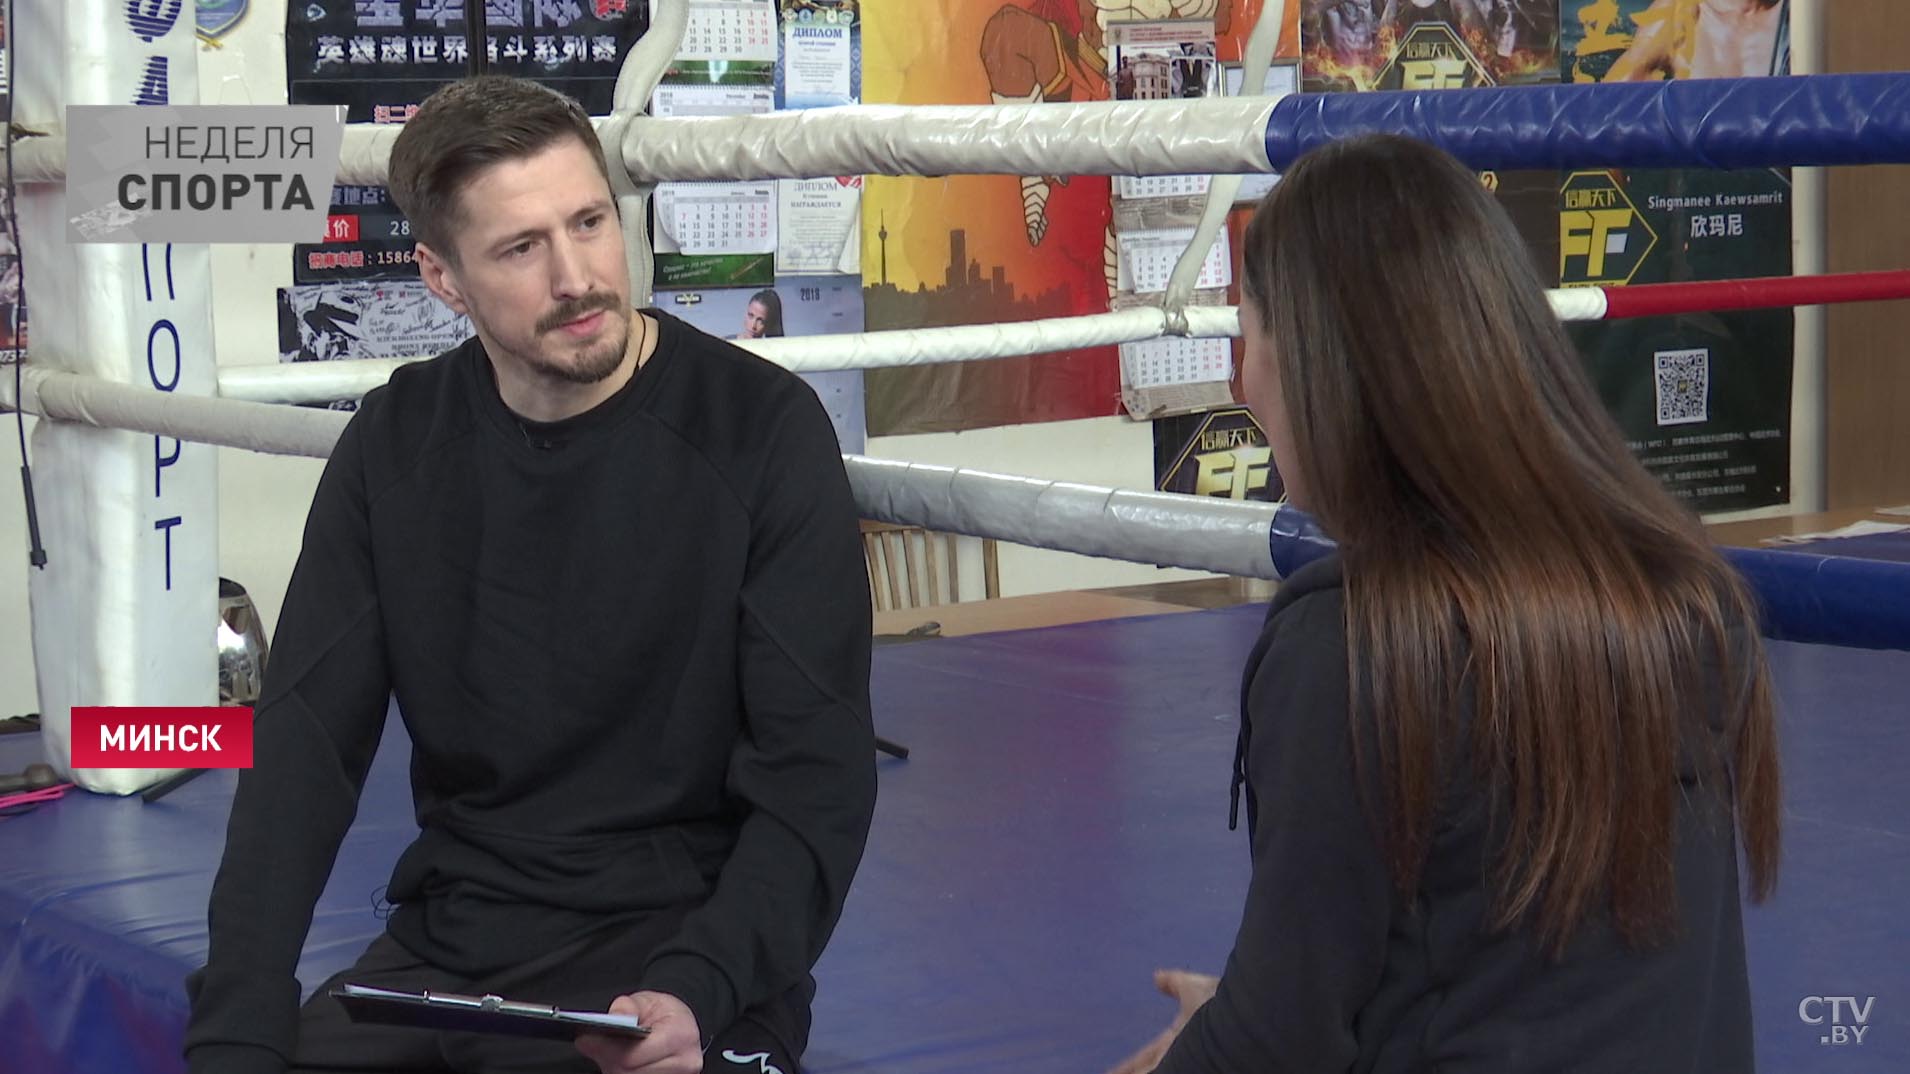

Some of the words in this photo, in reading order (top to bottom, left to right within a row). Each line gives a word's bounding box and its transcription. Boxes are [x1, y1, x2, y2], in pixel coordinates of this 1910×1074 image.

[792, 28, 843, 38] ДИПЛОМ
[1647, 195, 1711, 211] Singmanee
[1715, 191, 1783, 206] Kaewsamrit
[1690, 214, 1744, 238] 欣玛尼
